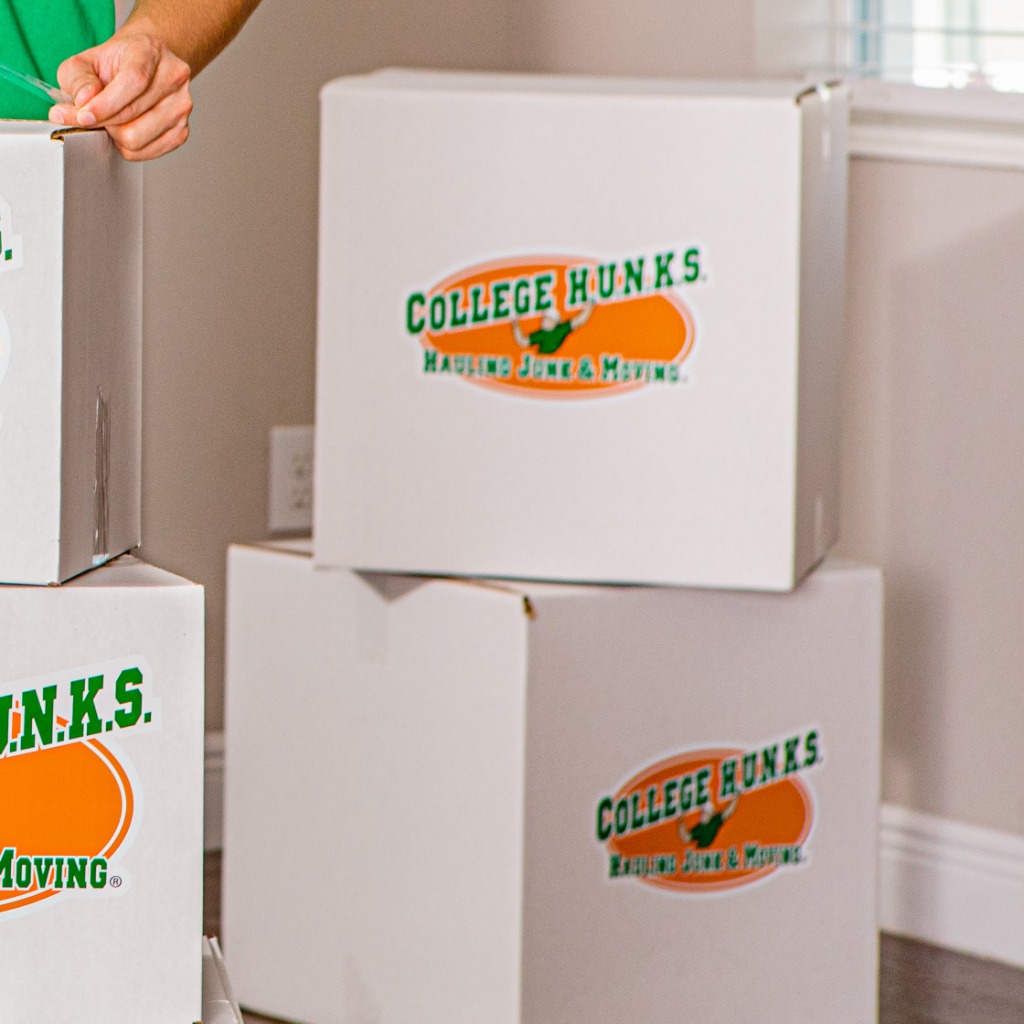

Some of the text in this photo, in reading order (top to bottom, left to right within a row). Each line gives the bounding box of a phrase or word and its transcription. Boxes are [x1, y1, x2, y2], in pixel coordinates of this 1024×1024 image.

[406, 273, 554, 335] COLLEGE
[423, 350, 511, 376] HAULING
[518, 355, 572, 380] JUNK
[578, 357, 594, 380] &
[596, 768, 711, 842] COLLEGE
